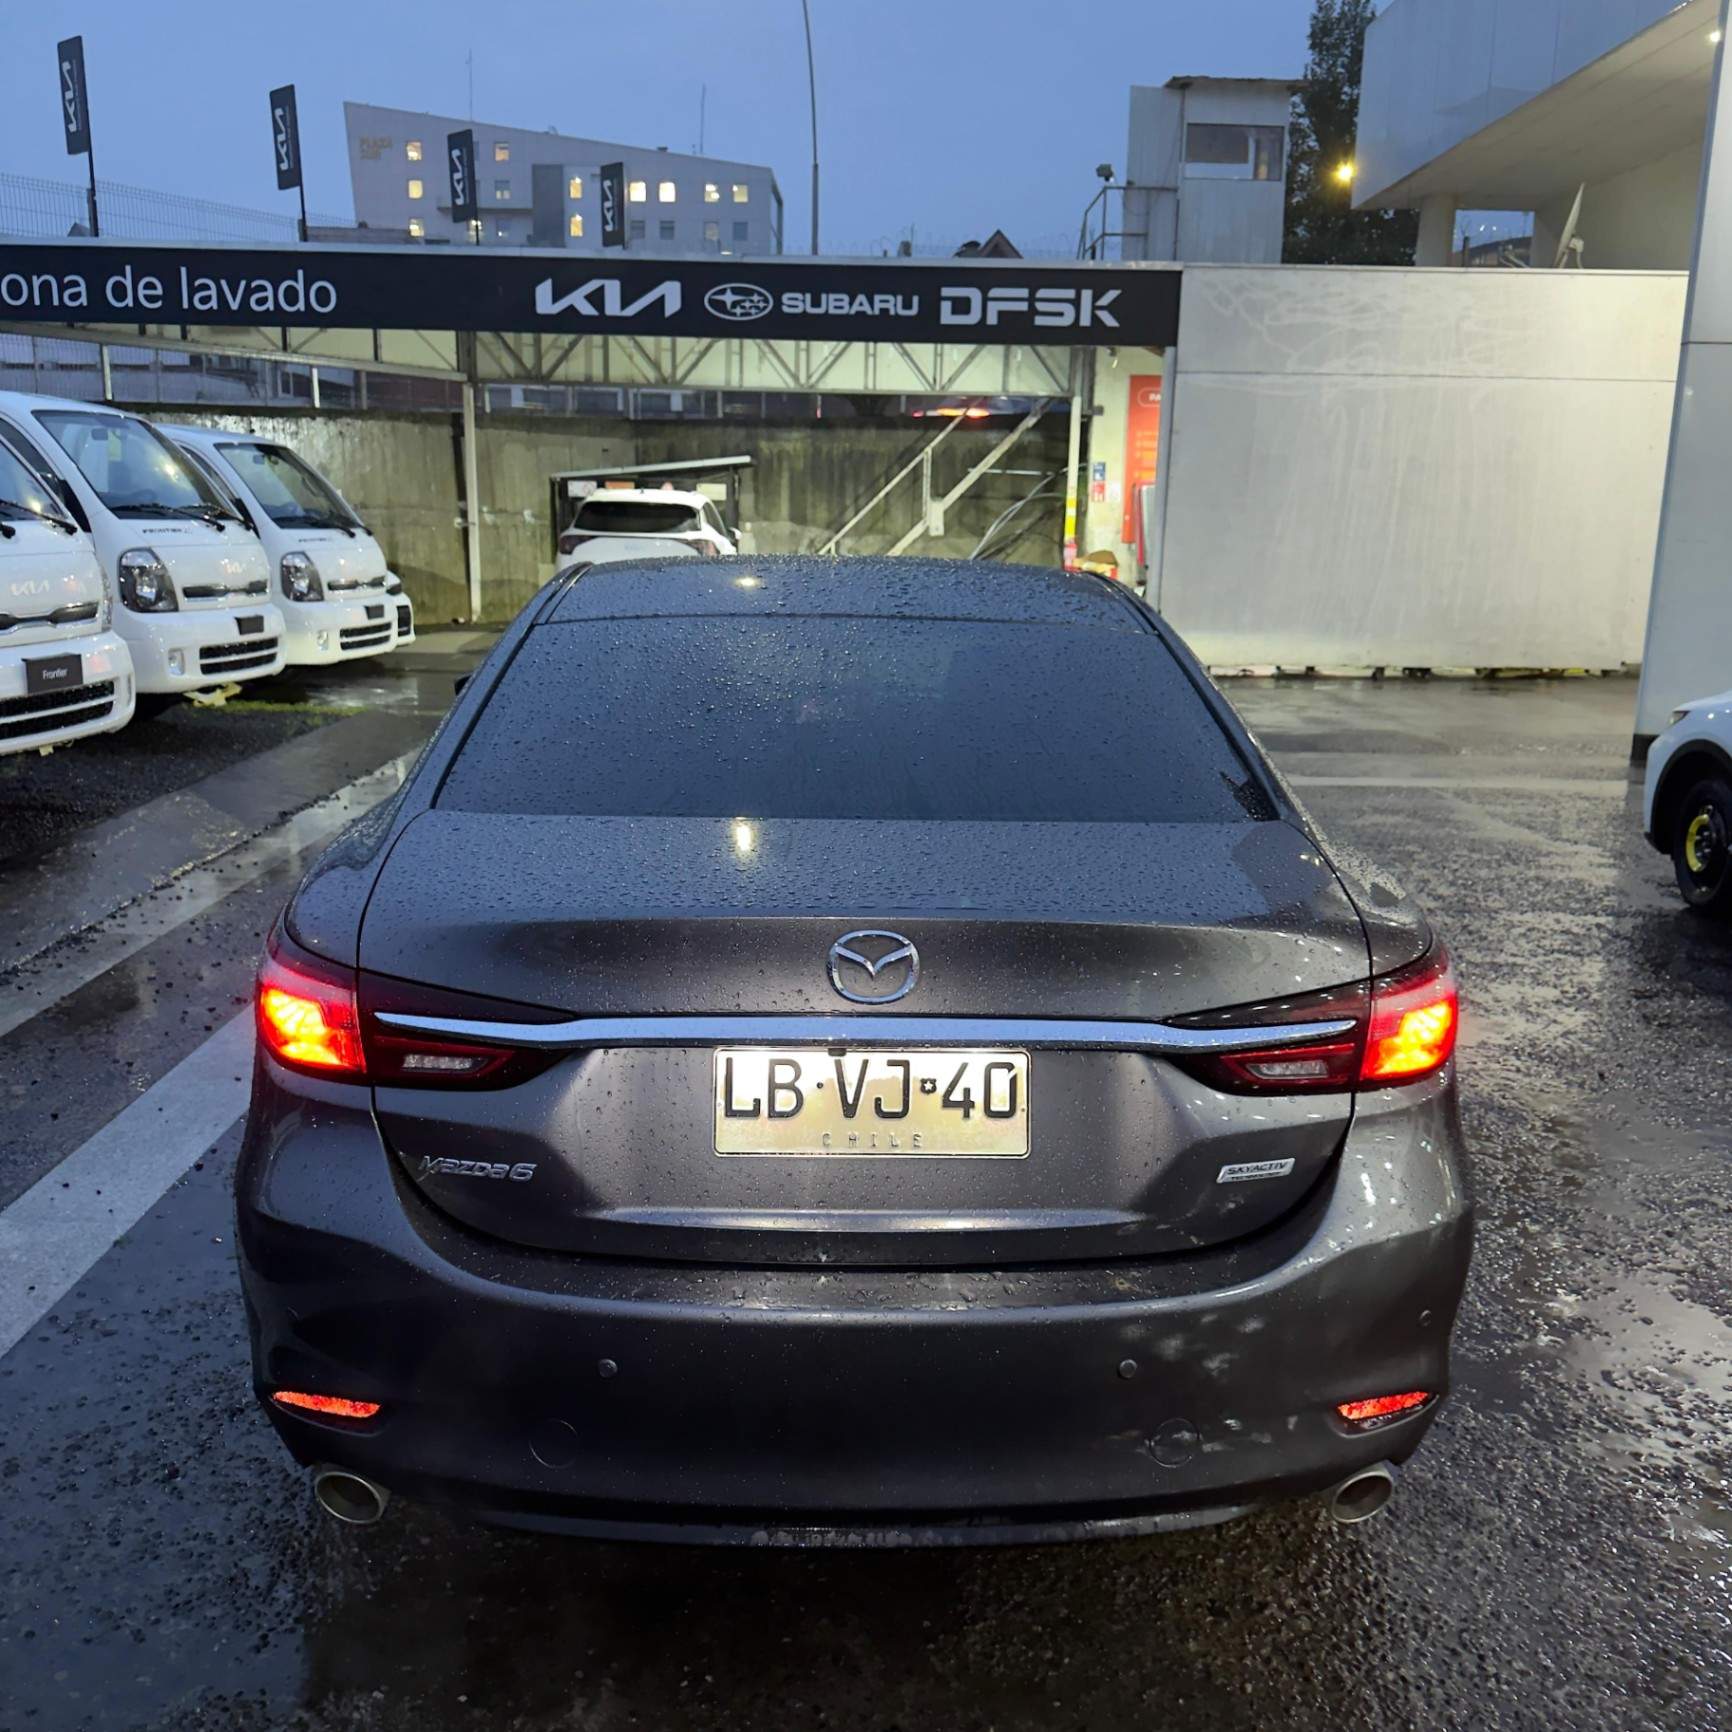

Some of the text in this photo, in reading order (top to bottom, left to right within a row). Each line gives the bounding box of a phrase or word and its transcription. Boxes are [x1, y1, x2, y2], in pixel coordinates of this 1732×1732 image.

[105, 264, 163, 309] de
[180, 266, 337, 313] lavado
[535, 278, 682, 318] KIA
[781, 292, 919, 317] SUBARU
[940, 287, 1122, 328] DFSK
[42, 667, 68, 680] Frontier
[822, 1132, 923, 1149] CHILE
[1227, 1162, 1288, 1175] SKYACTIV
